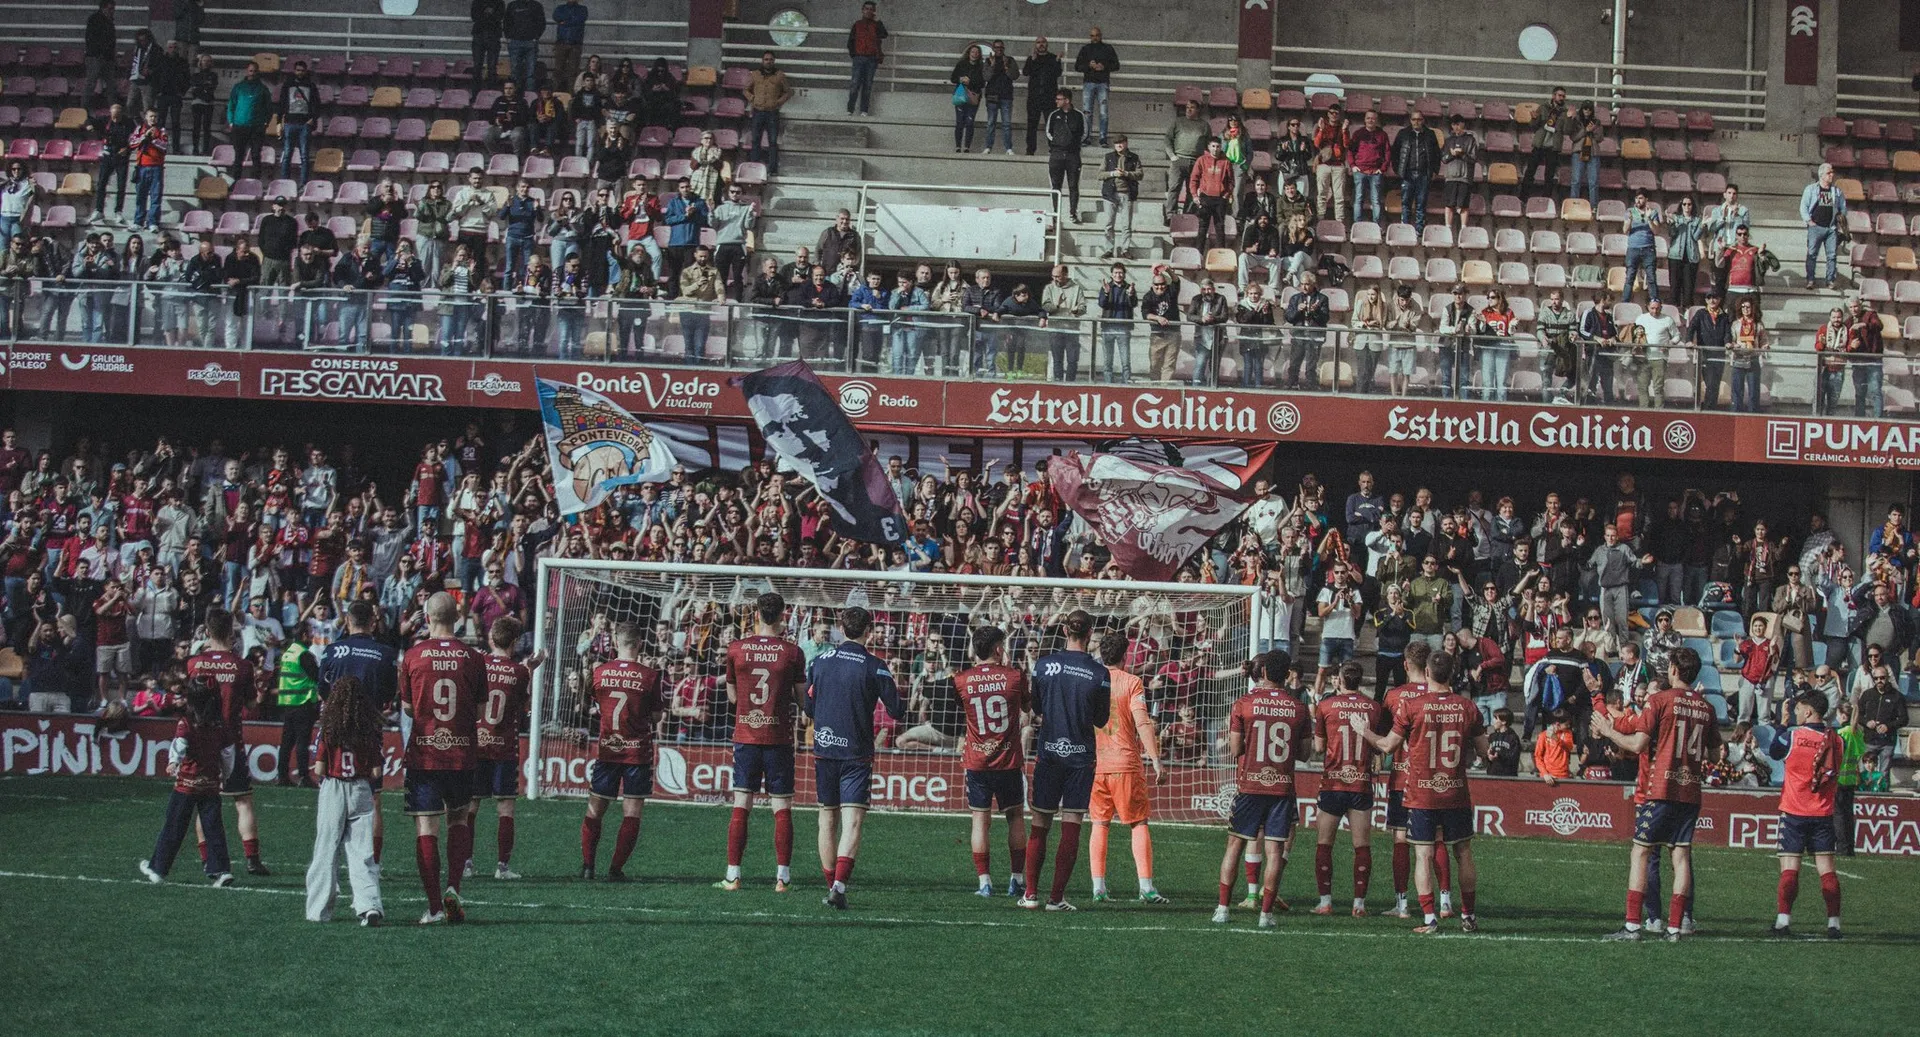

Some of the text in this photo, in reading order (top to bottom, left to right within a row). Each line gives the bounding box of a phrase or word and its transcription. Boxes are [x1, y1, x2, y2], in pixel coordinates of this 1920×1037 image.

[91, 354, 124, 364] GALICIA
[311, 358, 399, 375] CONSERVAS
[260, 368, 446, 401] PESCAMAR
[843, 392, 918, 408] Viva Radio
[986, 388, 1257, 434] Estrella Galicia
[1383, 405, 1654, 451] Estrella Galicia
[570, 429, 645, 454] PONTEVEDRA
[1803, 452, 1851, 464] CERÁMICA
[1860, 454, 1886, 465] BAÑO
[420, 649, 471, 658] ABANCA
[741, 643, 785, 652] ABANCA
[754, 652, 778, 662] IRAZU
[194, 660, 239, 671] ABANCA
[432, 660, 458, 671] RUFO
[602, 669, 643, 679] ABANCA
[966, 674, 1007, 683] ABANCA
[601, 679, 620, 689] ALEX
[749, 668, 770, 705] 3
[978, 681, 1007, 693] GARAY
[432, 678, 457, 722] 9
[1252, 698, 1297, 708] ABANCA
[1331, 701, 1375, 711] ABANCA
[1423, 702, 1465, 712] ABANCA
[609, 690, 629, 731] 7
[969, 694, 1009, 735] 19
[1253, 705, 1296, 718] DALISSON
[1435, 713, 1464, 724] CUESTA
[416, 735, 470, 747] PESCAMAR
[1252, 719, 1292, 764] 18
[1337, 724, 1364, 761] 11
[1675, 720, 1704, 763] 14
[1424, 730, 1462, 769] 15
[341, 751, 356, 778] 9
[871, 773, 947, 803] ence
[1525, 810, 1614, 829] PESCAMAR
